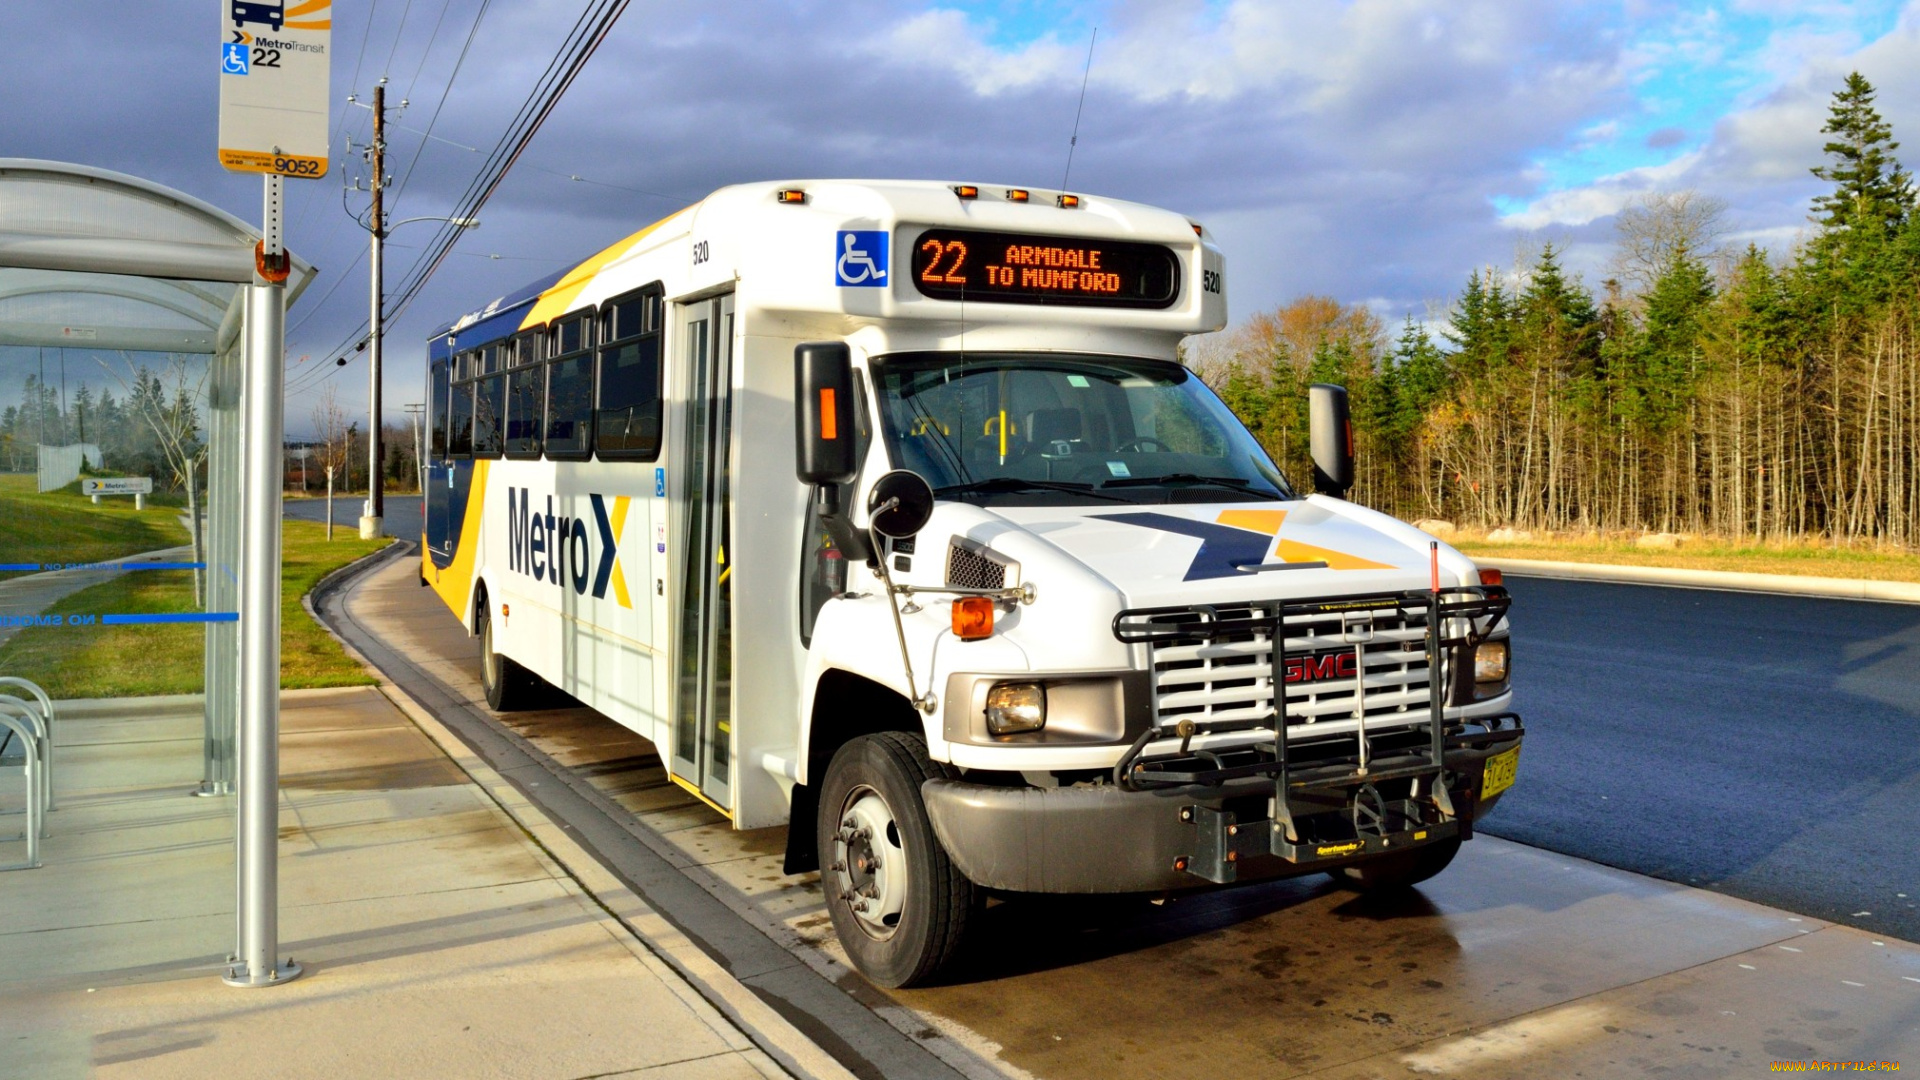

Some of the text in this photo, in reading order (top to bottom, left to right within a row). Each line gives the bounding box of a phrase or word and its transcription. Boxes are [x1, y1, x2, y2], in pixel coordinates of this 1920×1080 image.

[255, 36, 325, 54] MetroTransit
[252, 48, 281, 68] 22
[274, 157, 320, 175] 9052
[693, 240, 709, 265] 520
[922, 239, 966, 283] 22
[1006, 245, 1101, 269] ARMDALE
[985, 265, 1120, 292] TO MUMFORD
[1203, 269, 1221, 295] 520
[44, 563, 62, 571] NO
[1284, 653, 1357, 682] GMC
